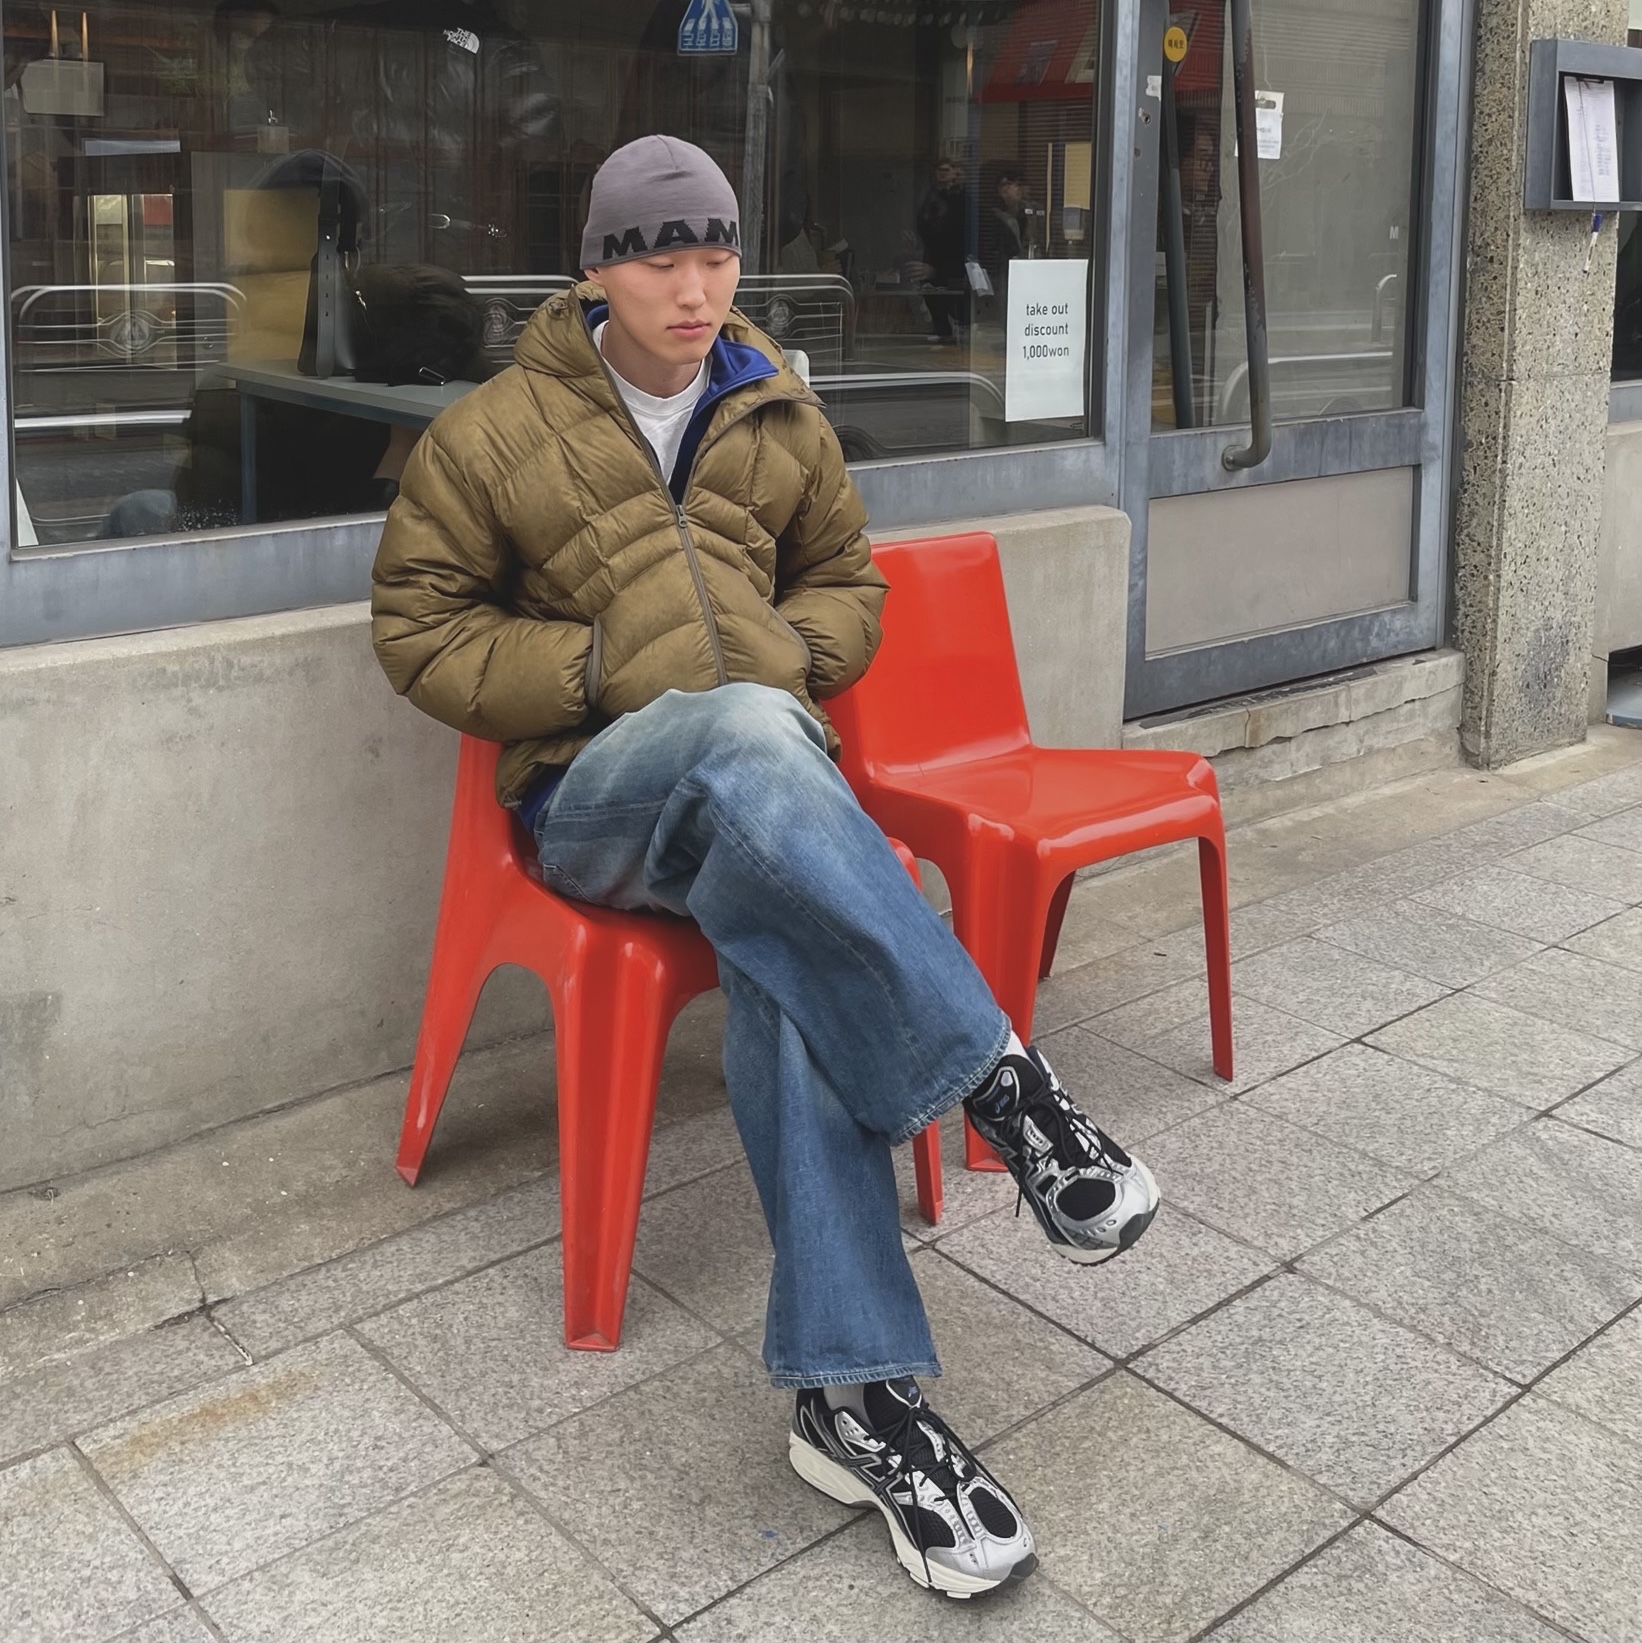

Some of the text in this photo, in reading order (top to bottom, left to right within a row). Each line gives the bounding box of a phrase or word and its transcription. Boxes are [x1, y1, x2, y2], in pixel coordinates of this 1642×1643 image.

[1026, 303, 1068, 316] take out
[1024, 323, 1069, 337] discount
[1023, 345, 1070, 361] 1,000won
